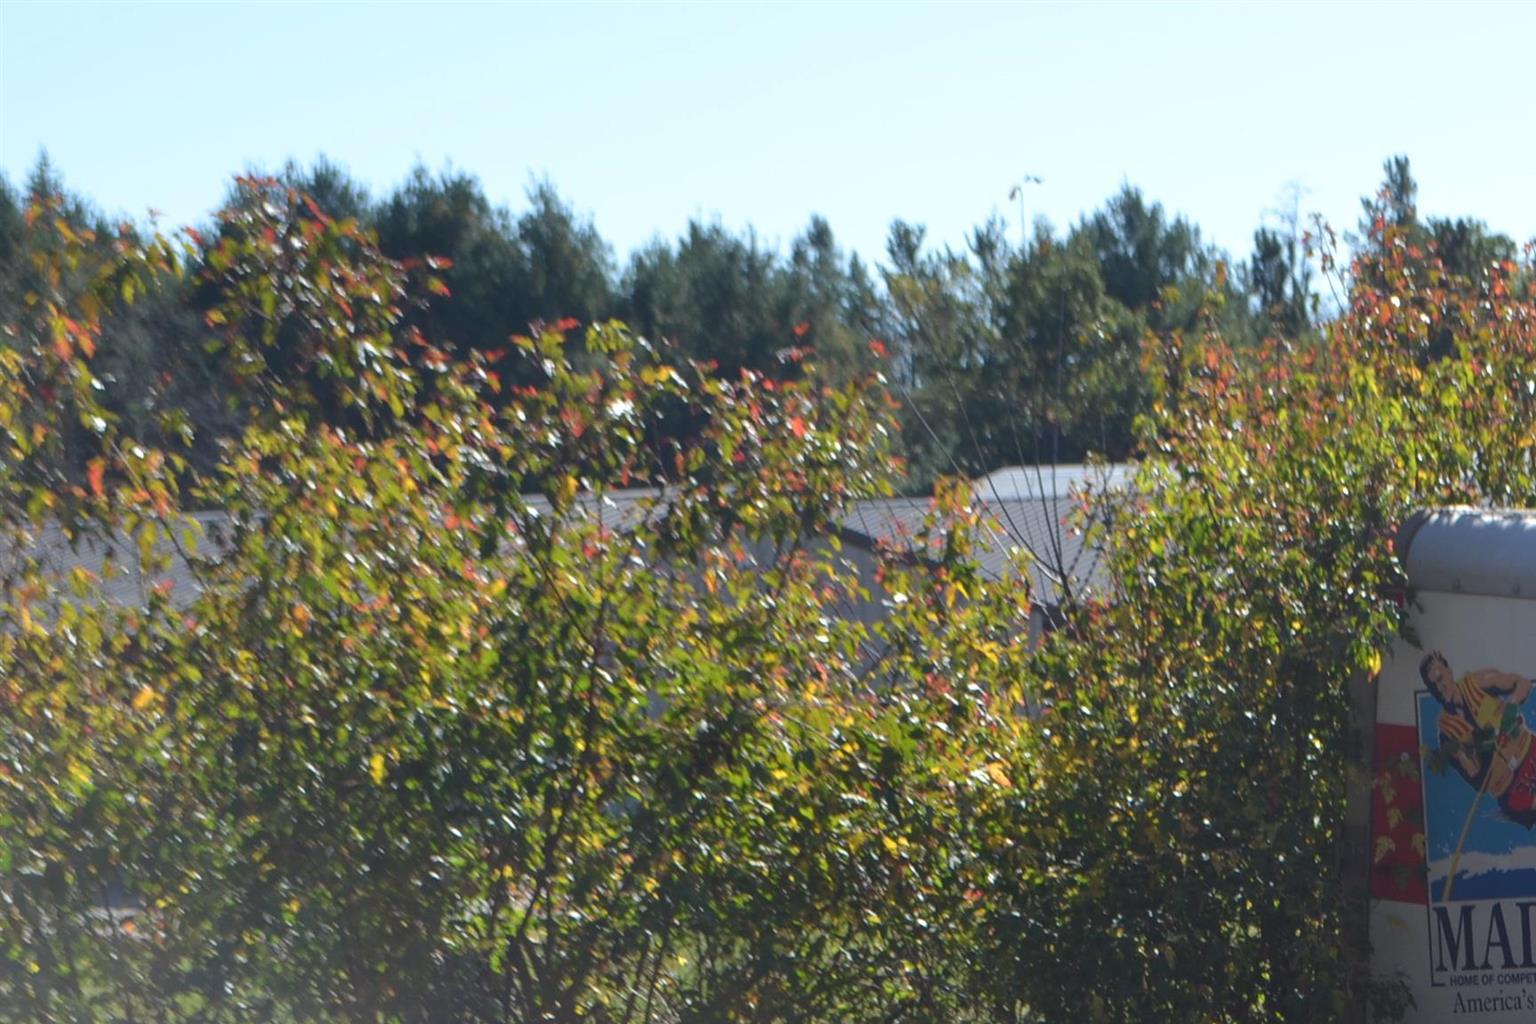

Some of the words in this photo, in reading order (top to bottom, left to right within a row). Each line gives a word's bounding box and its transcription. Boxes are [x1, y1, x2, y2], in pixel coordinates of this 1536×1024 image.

[1450, 975, 1478, 986] HOME
[1482, 974, 1495, 985] OF
[1453, 989, 1534, 1014] America's
